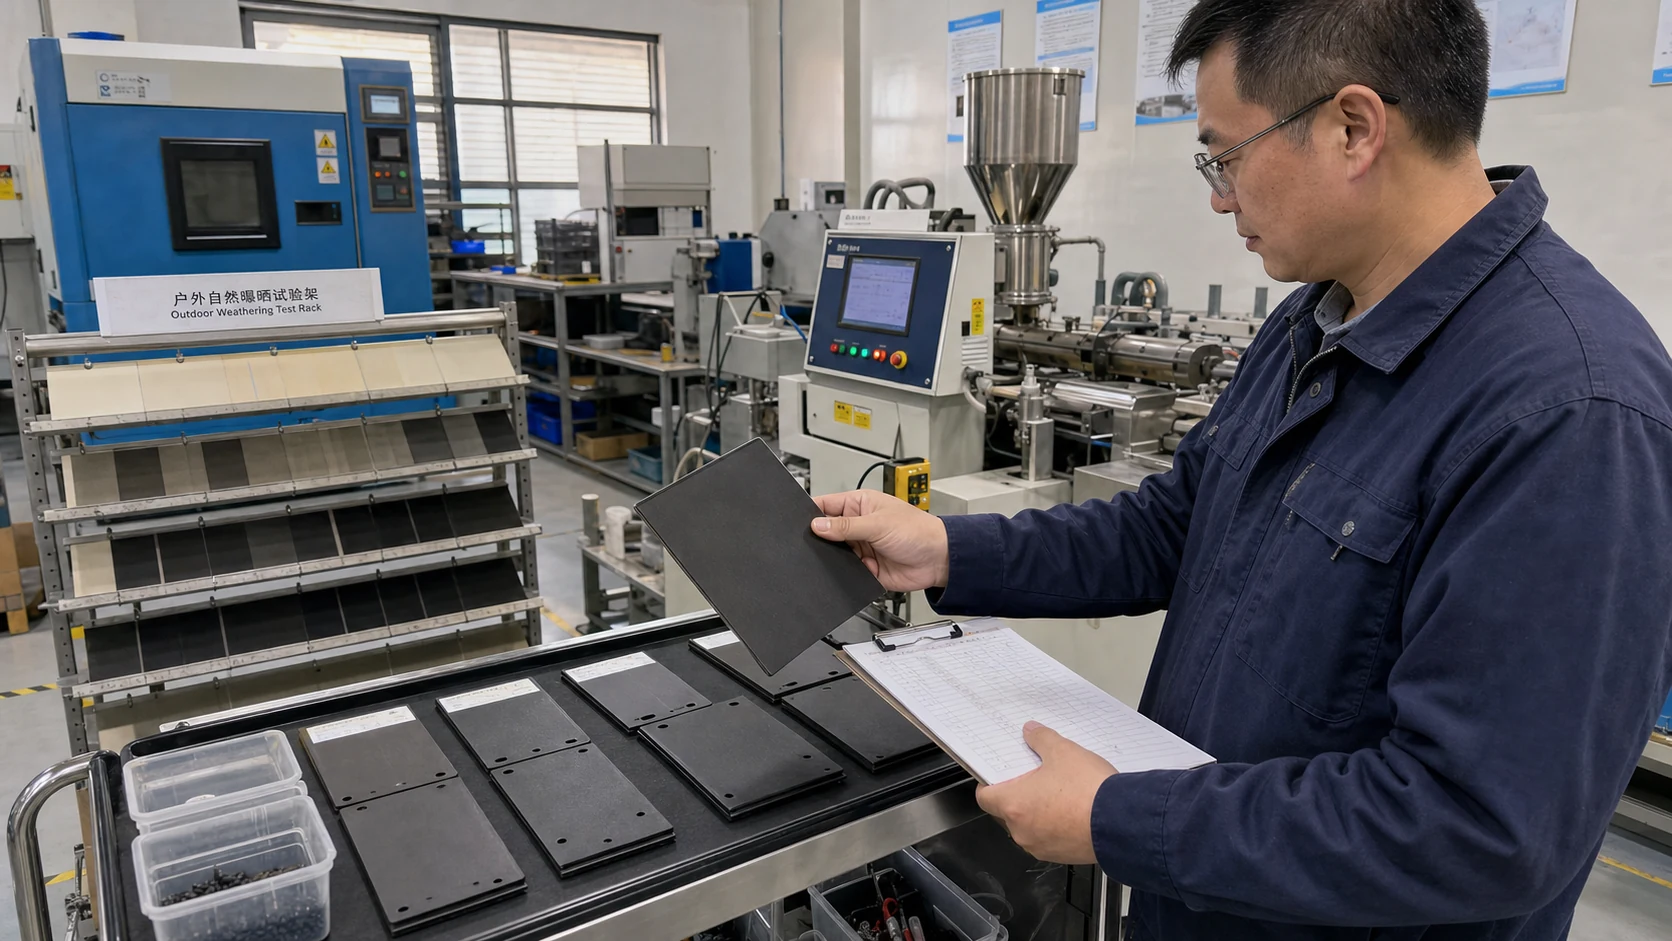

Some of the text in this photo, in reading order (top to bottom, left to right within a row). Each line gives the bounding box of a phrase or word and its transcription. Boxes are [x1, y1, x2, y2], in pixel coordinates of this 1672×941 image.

[171, 303, 322, 319] Outdoor Weathering Test Rack
